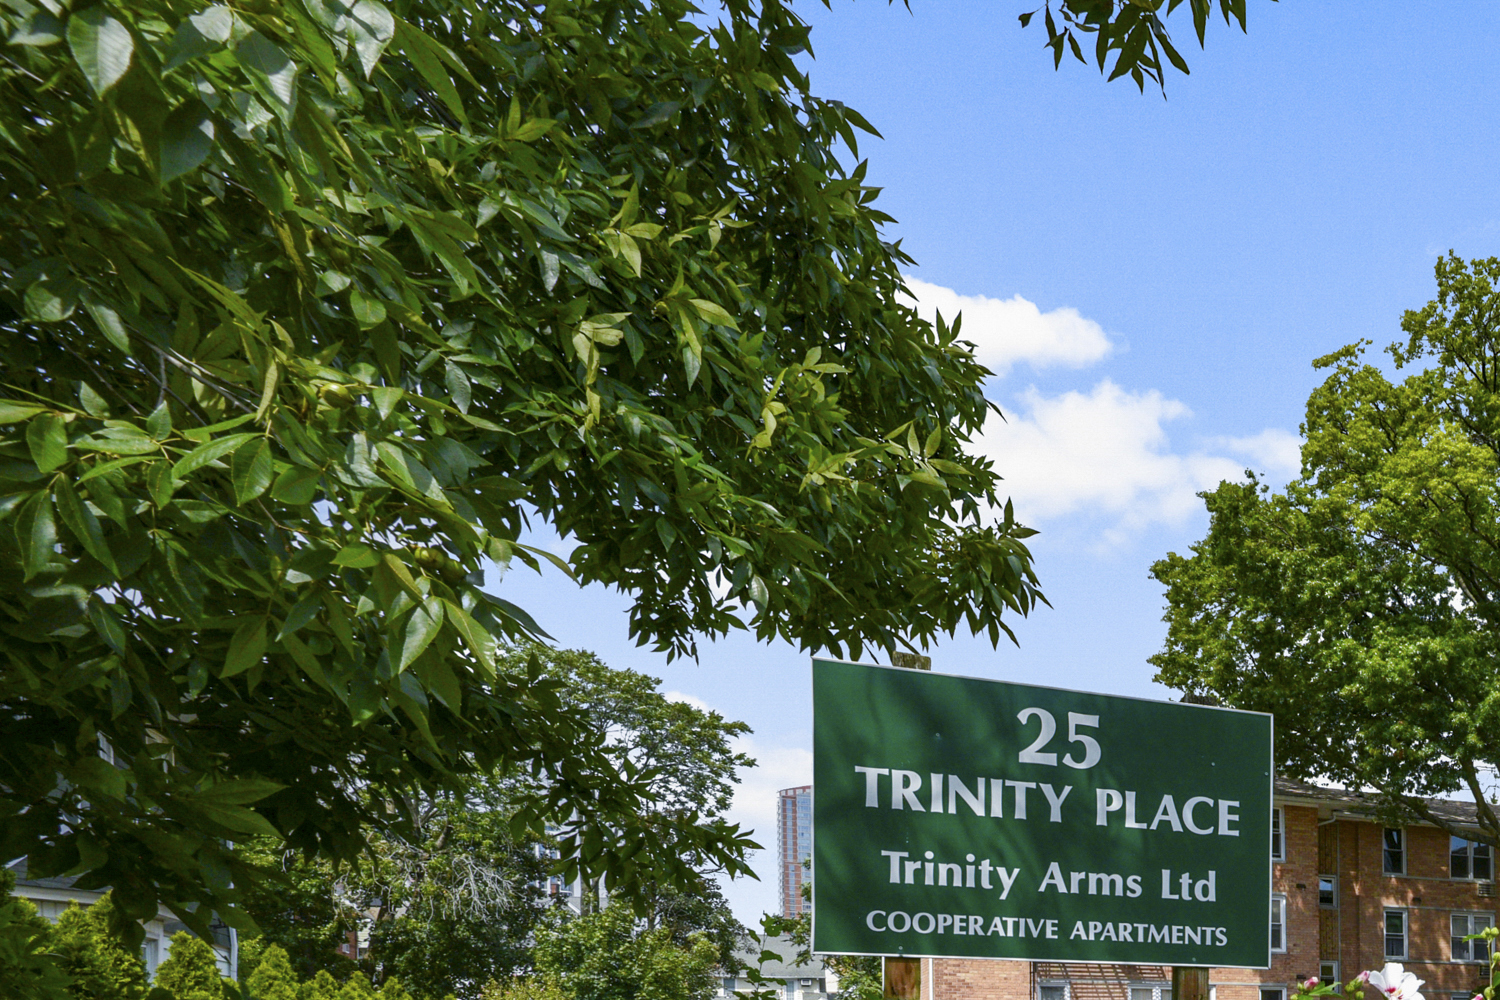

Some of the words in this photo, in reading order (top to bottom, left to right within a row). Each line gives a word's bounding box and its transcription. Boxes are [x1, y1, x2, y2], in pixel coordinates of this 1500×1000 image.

[1017, 707, 1101, 769] 25
[855, 766, 1073, 823] TRINITY
[1096, 788, 1240, 836] PLACE
[881, 851, 1020, 899] Trinity
[1039, 862, 1142, 898] Arms
[1161, 869, 1216, 902] Ltd
[866, 910, 1058, 939] COOPERATIVE
[1070, 920, 1228, 946] APARTMENTS
